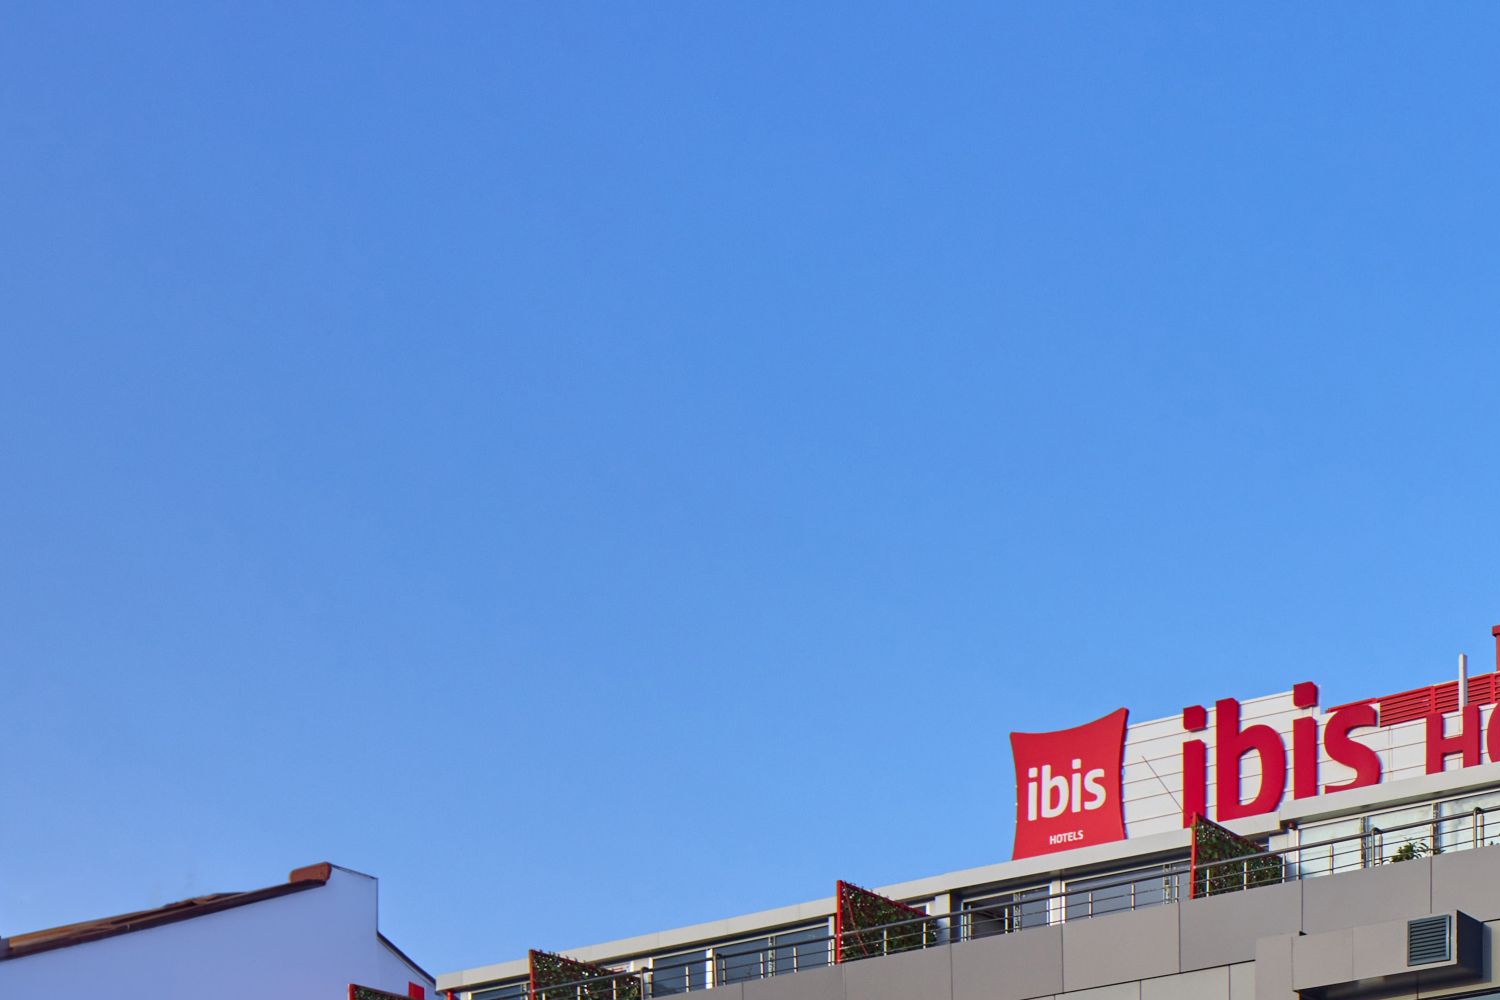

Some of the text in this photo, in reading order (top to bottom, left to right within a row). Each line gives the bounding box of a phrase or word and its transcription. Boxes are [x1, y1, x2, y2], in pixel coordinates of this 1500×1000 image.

[1182, 681, 1382, 829] ibis
[1027, 758, 1107, 822] ibis
[1049, 830, 1084, 845] HOTELS
